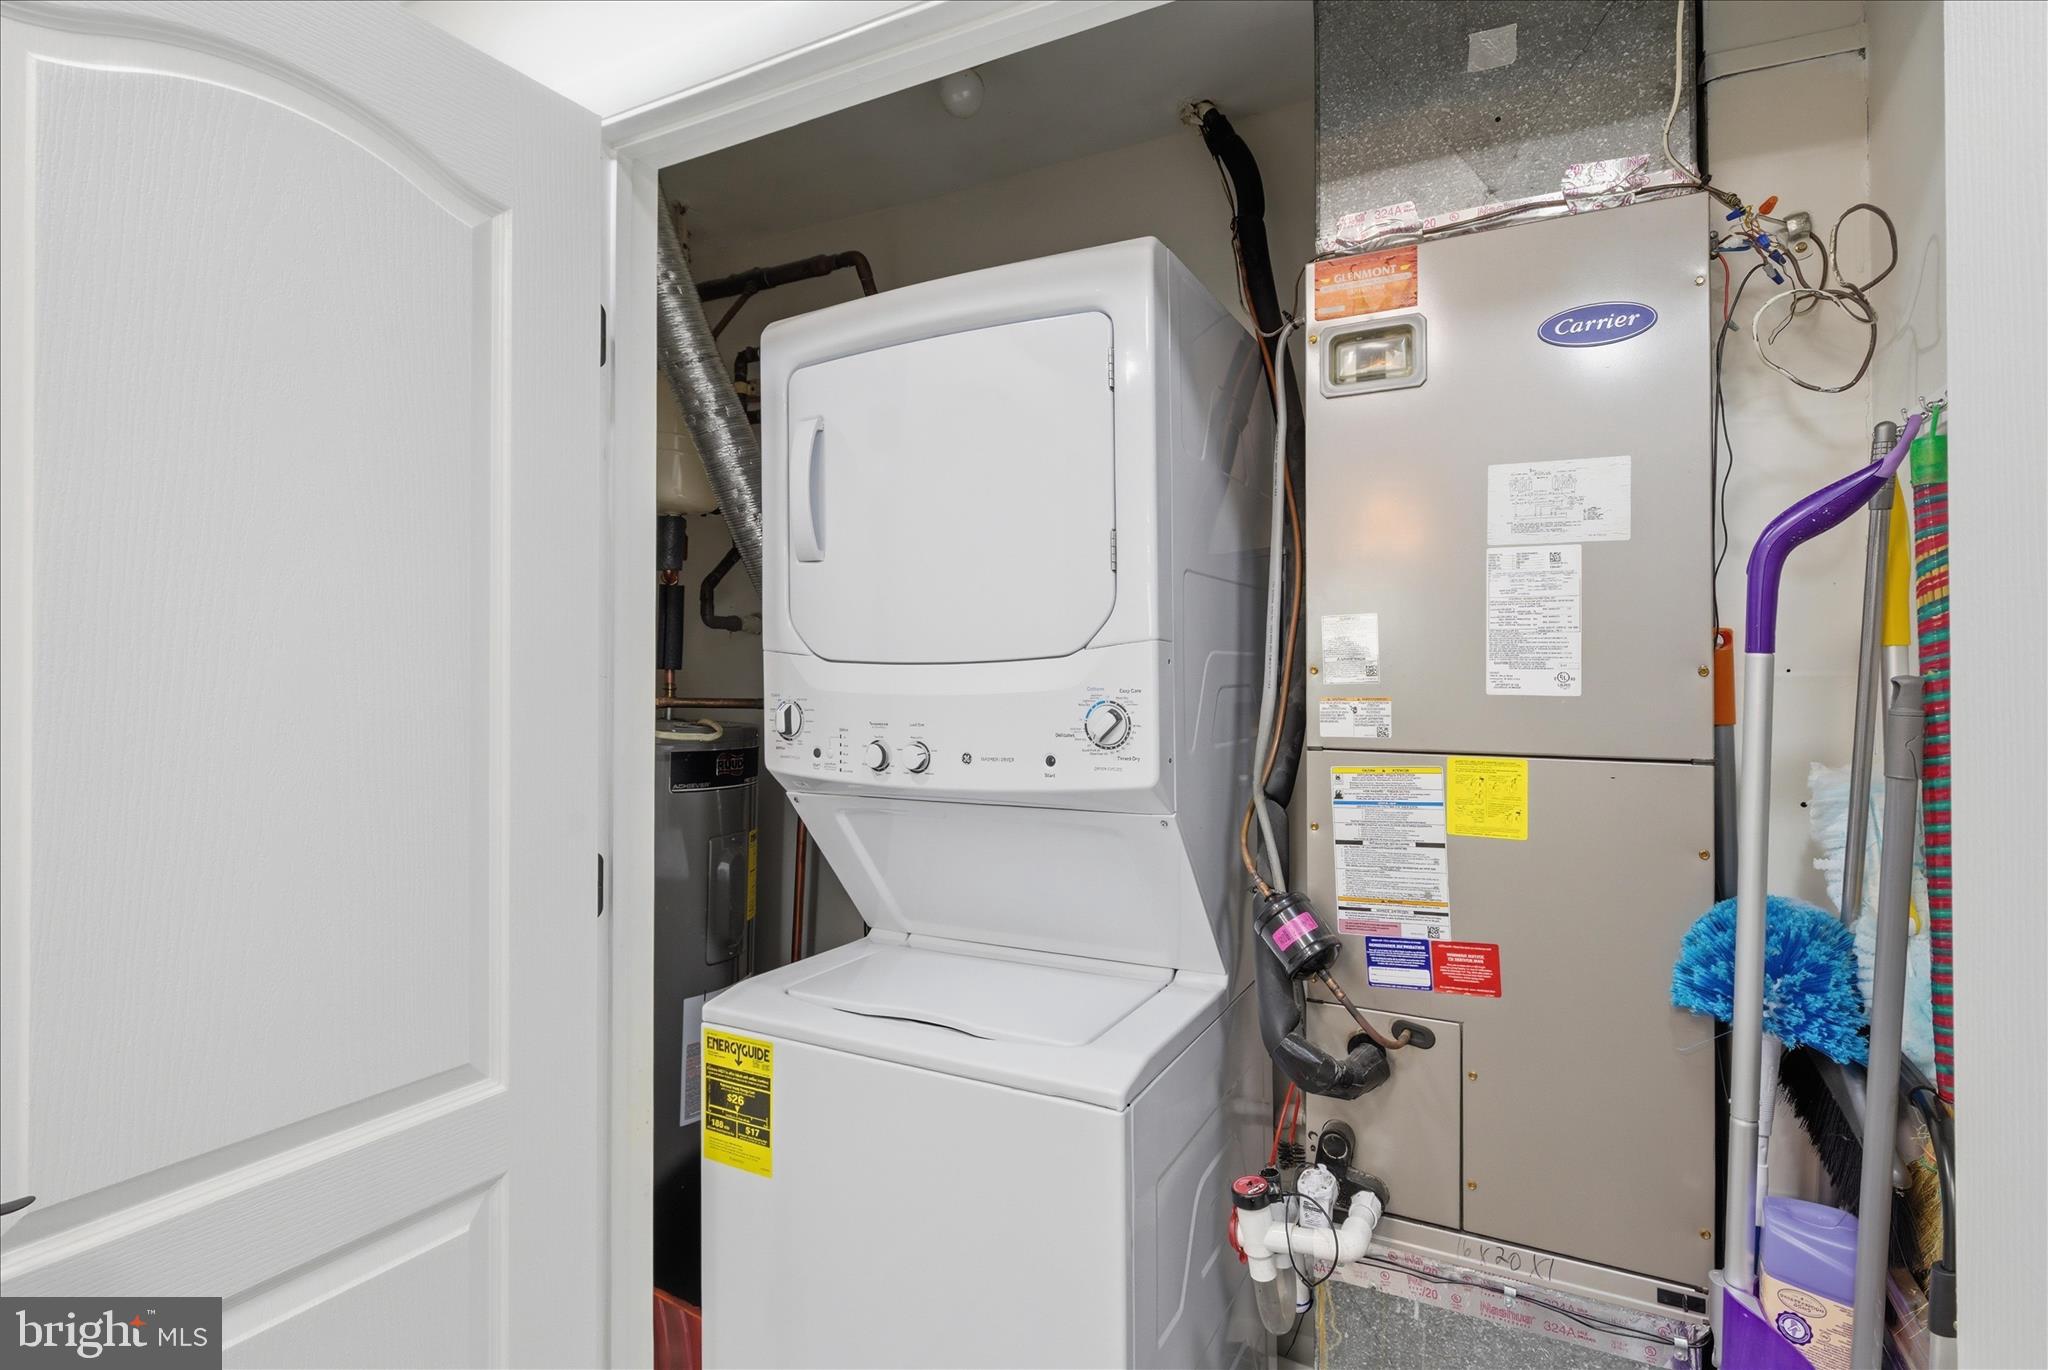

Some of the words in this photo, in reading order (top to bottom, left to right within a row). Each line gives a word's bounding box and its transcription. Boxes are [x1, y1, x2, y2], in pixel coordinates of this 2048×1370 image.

[1334, 264, 1398, 284] GLENMONT
[1554, 313, 1640, 335] Carrier
[707, 1036, 770, 1063] ENERGYGUIDE
[727, 1094, 744, 1106] $26
[745, 1127, 760, 1136] $17
[1496, 1246, 1521, 1272] 20
[1543, 1320, 1575, 1339] 324A
